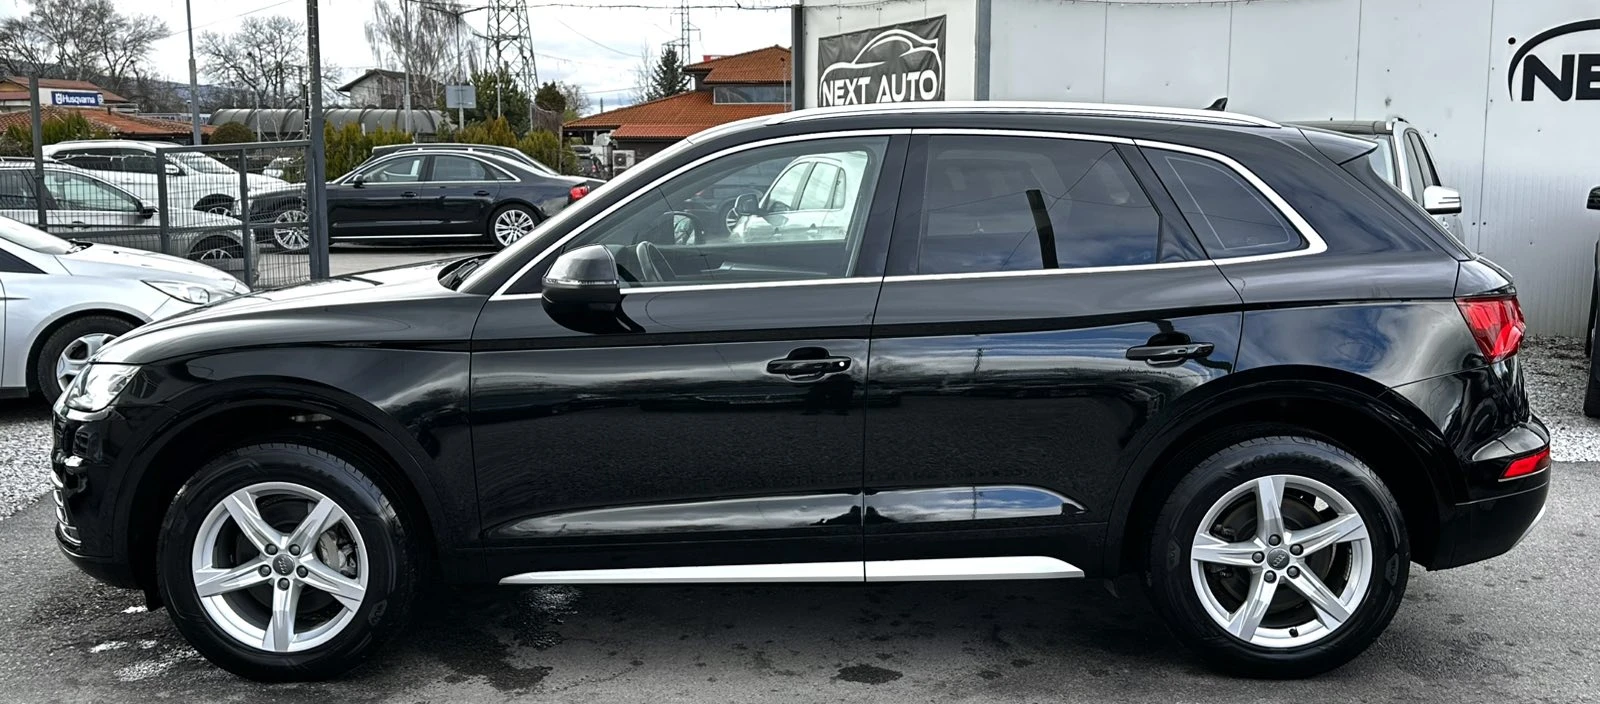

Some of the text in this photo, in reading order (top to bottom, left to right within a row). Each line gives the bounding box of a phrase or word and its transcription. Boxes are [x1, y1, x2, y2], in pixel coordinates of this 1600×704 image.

[62, 94, 96, 104] Husqvarna
[822, 69, 938, 107] NEXT AUTO
